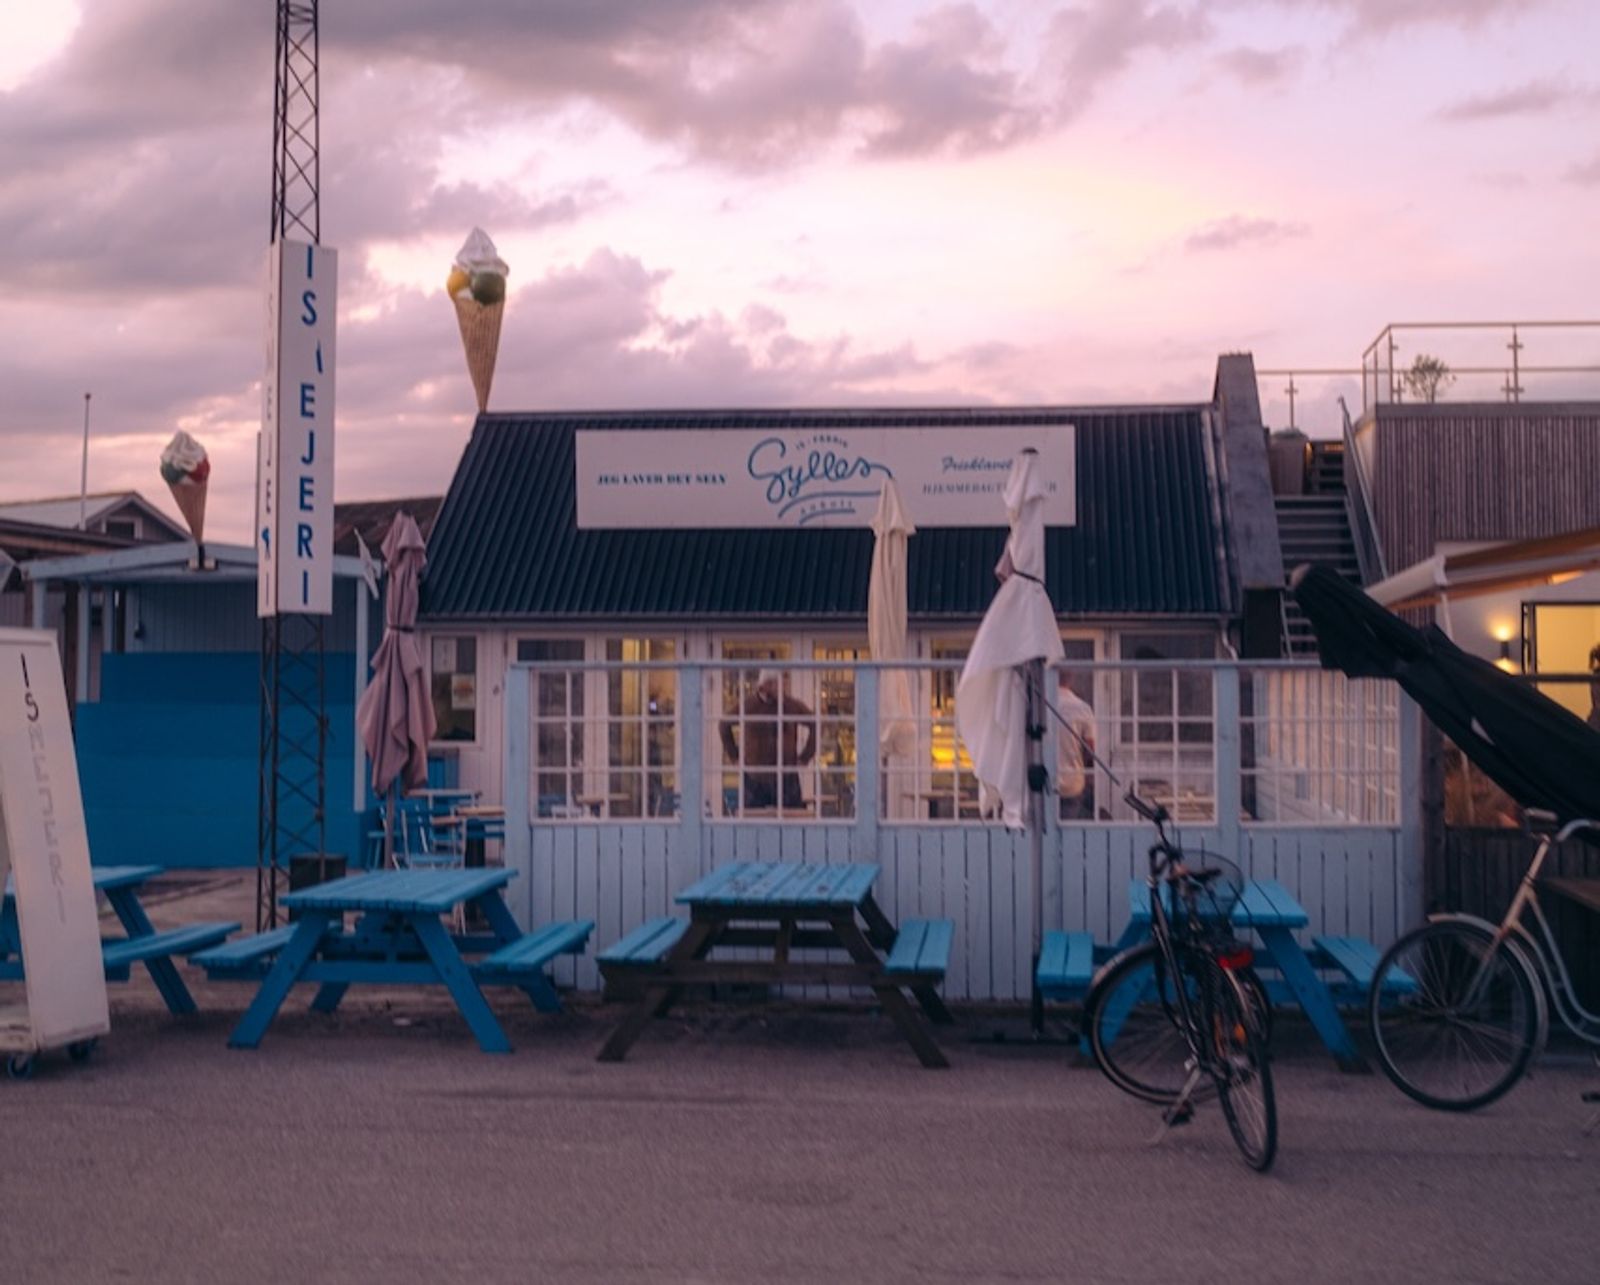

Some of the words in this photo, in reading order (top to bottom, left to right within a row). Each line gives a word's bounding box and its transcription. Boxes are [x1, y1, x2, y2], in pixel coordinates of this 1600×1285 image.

[598, 473, 620, 485] JEG
[623, 473, 663, 485] LAVER
[667, 473, 691, 485] DET
[747, 437, 895, 503] Gylles
